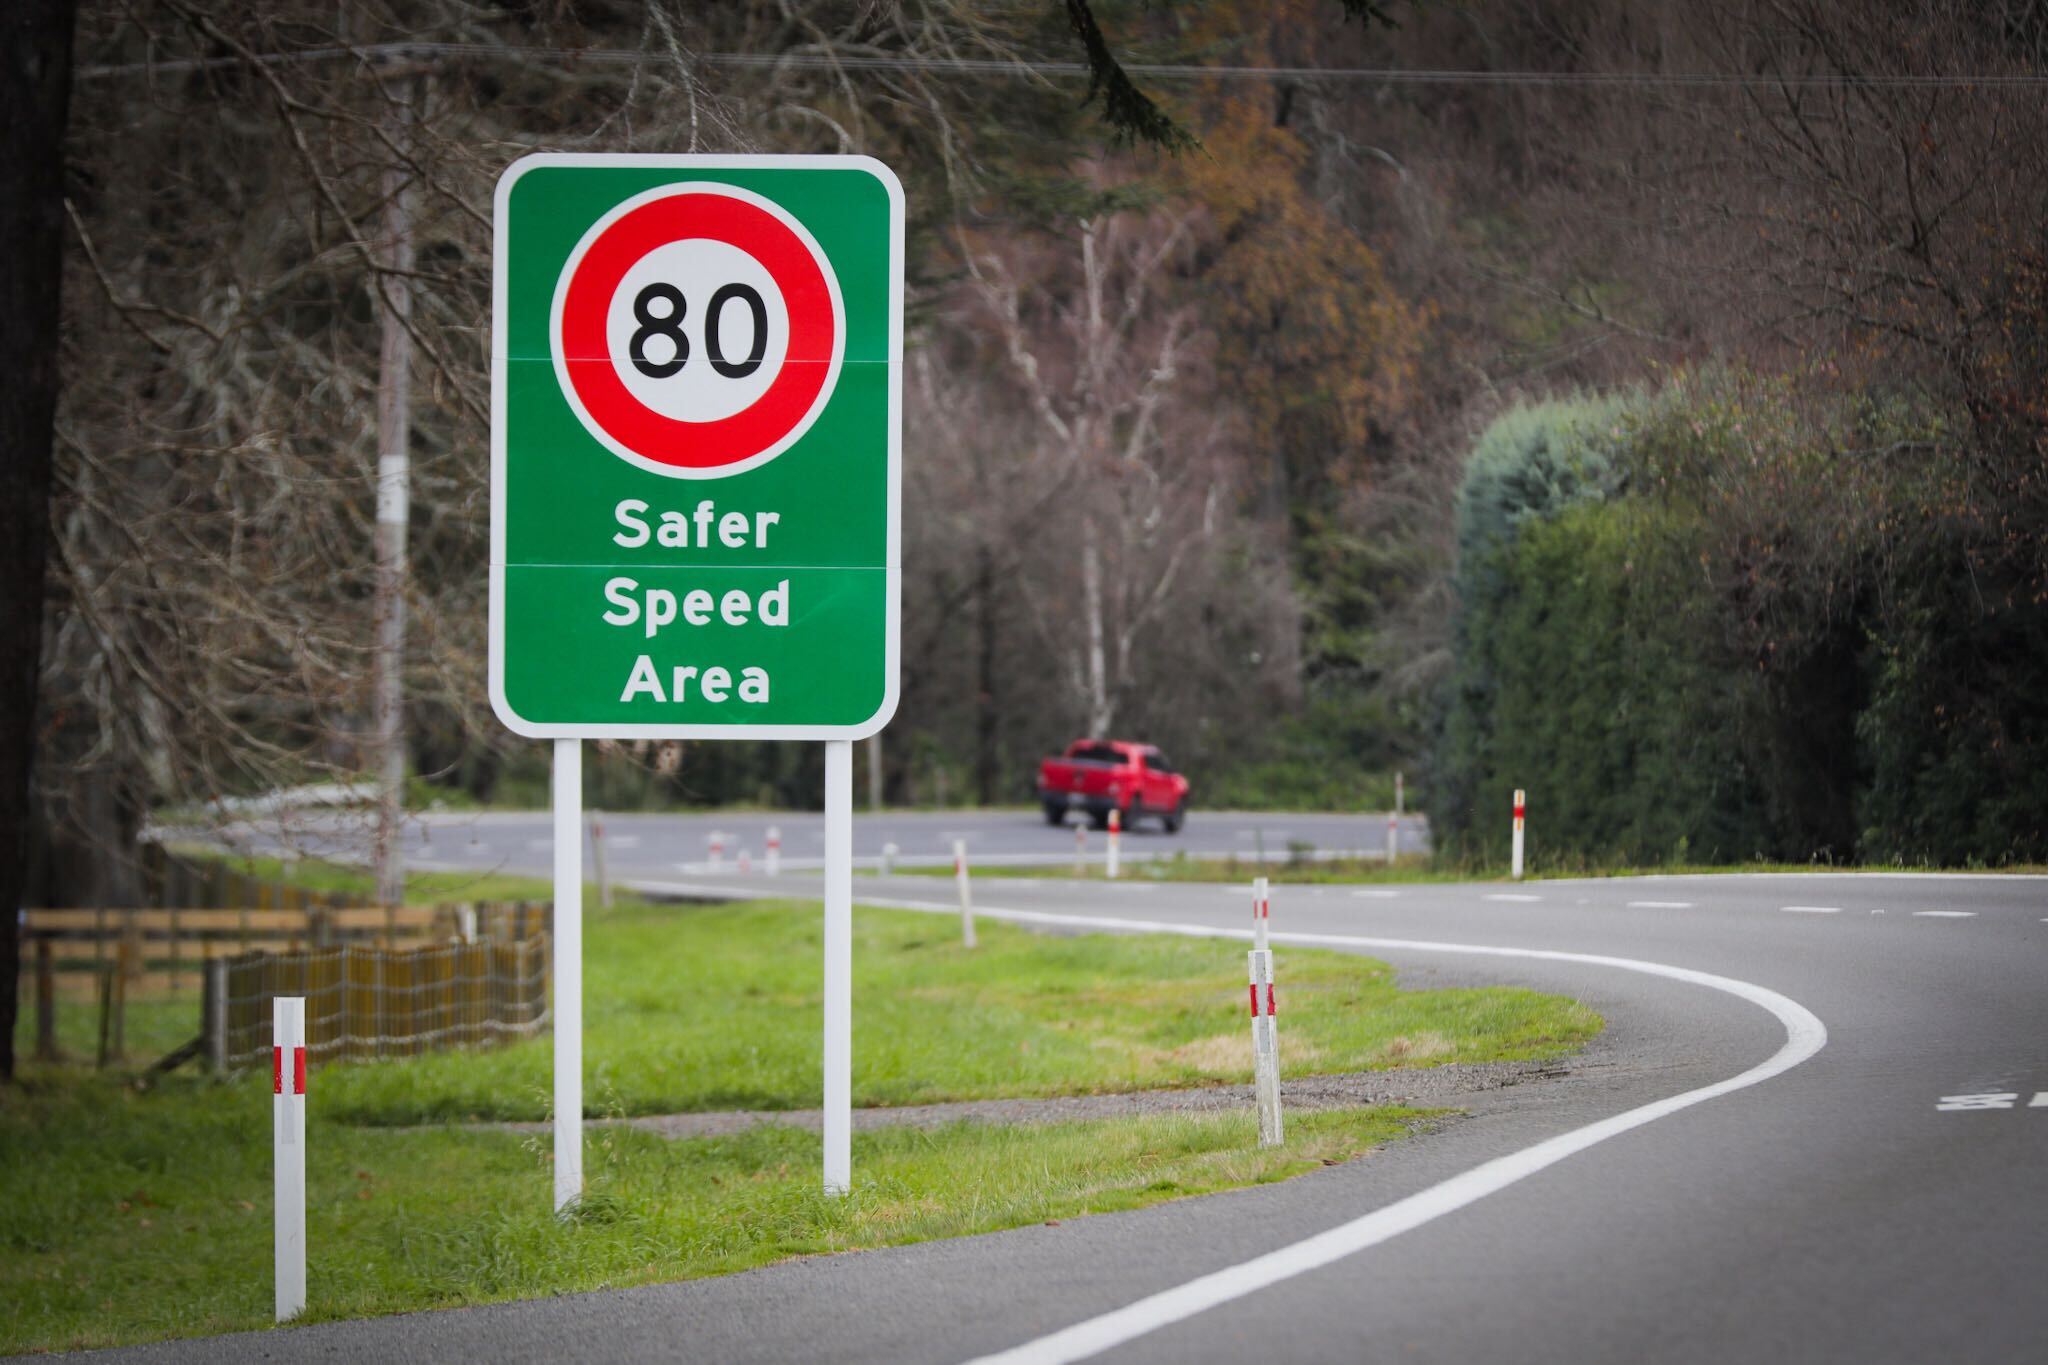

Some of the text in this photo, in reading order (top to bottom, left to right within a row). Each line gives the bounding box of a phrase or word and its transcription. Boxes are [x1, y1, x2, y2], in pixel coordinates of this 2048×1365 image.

[629, 282, 768, 379] 80
[613, 499, 780, 548] Safer
[602, 577, 790, 639] Speed
[620, 654, 770, 703] Area
